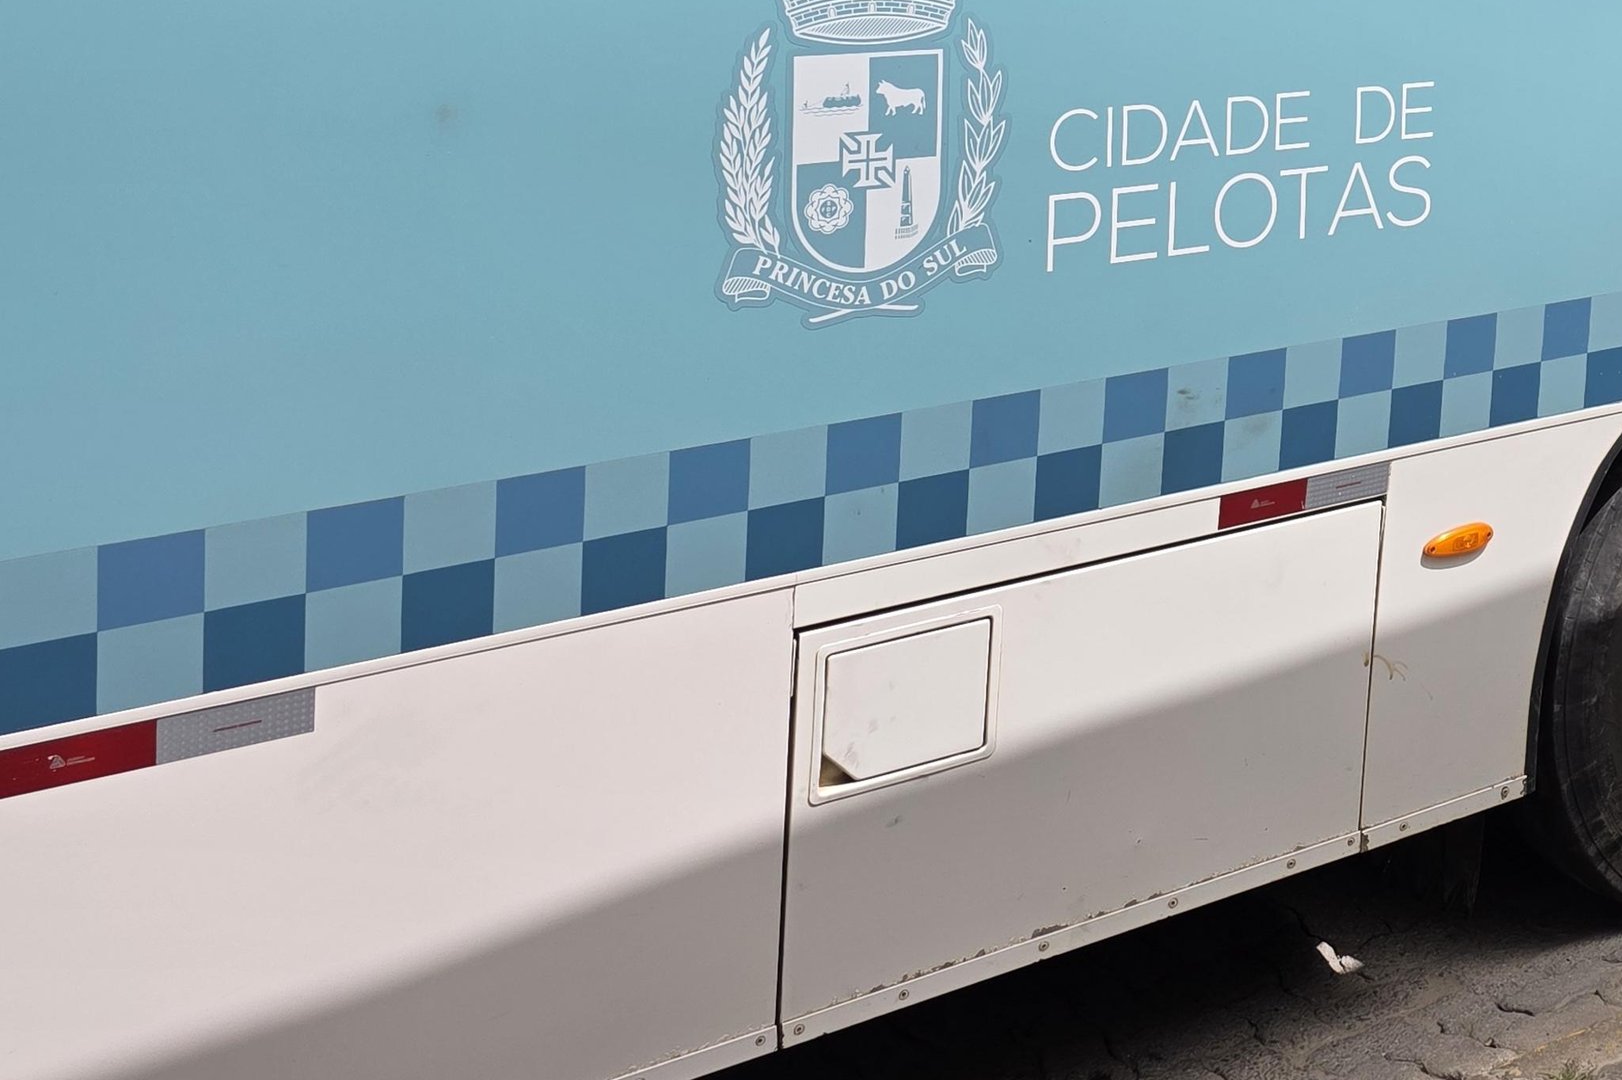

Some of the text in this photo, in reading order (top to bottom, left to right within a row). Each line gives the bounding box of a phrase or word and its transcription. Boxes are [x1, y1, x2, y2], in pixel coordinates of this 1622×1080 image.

[1050, 81, 1435, 172] CIDADE DE
[1047, 155, 1432, 272] PELOTAS
[752, 238, 967, 305] PRINCESA DO SUL
